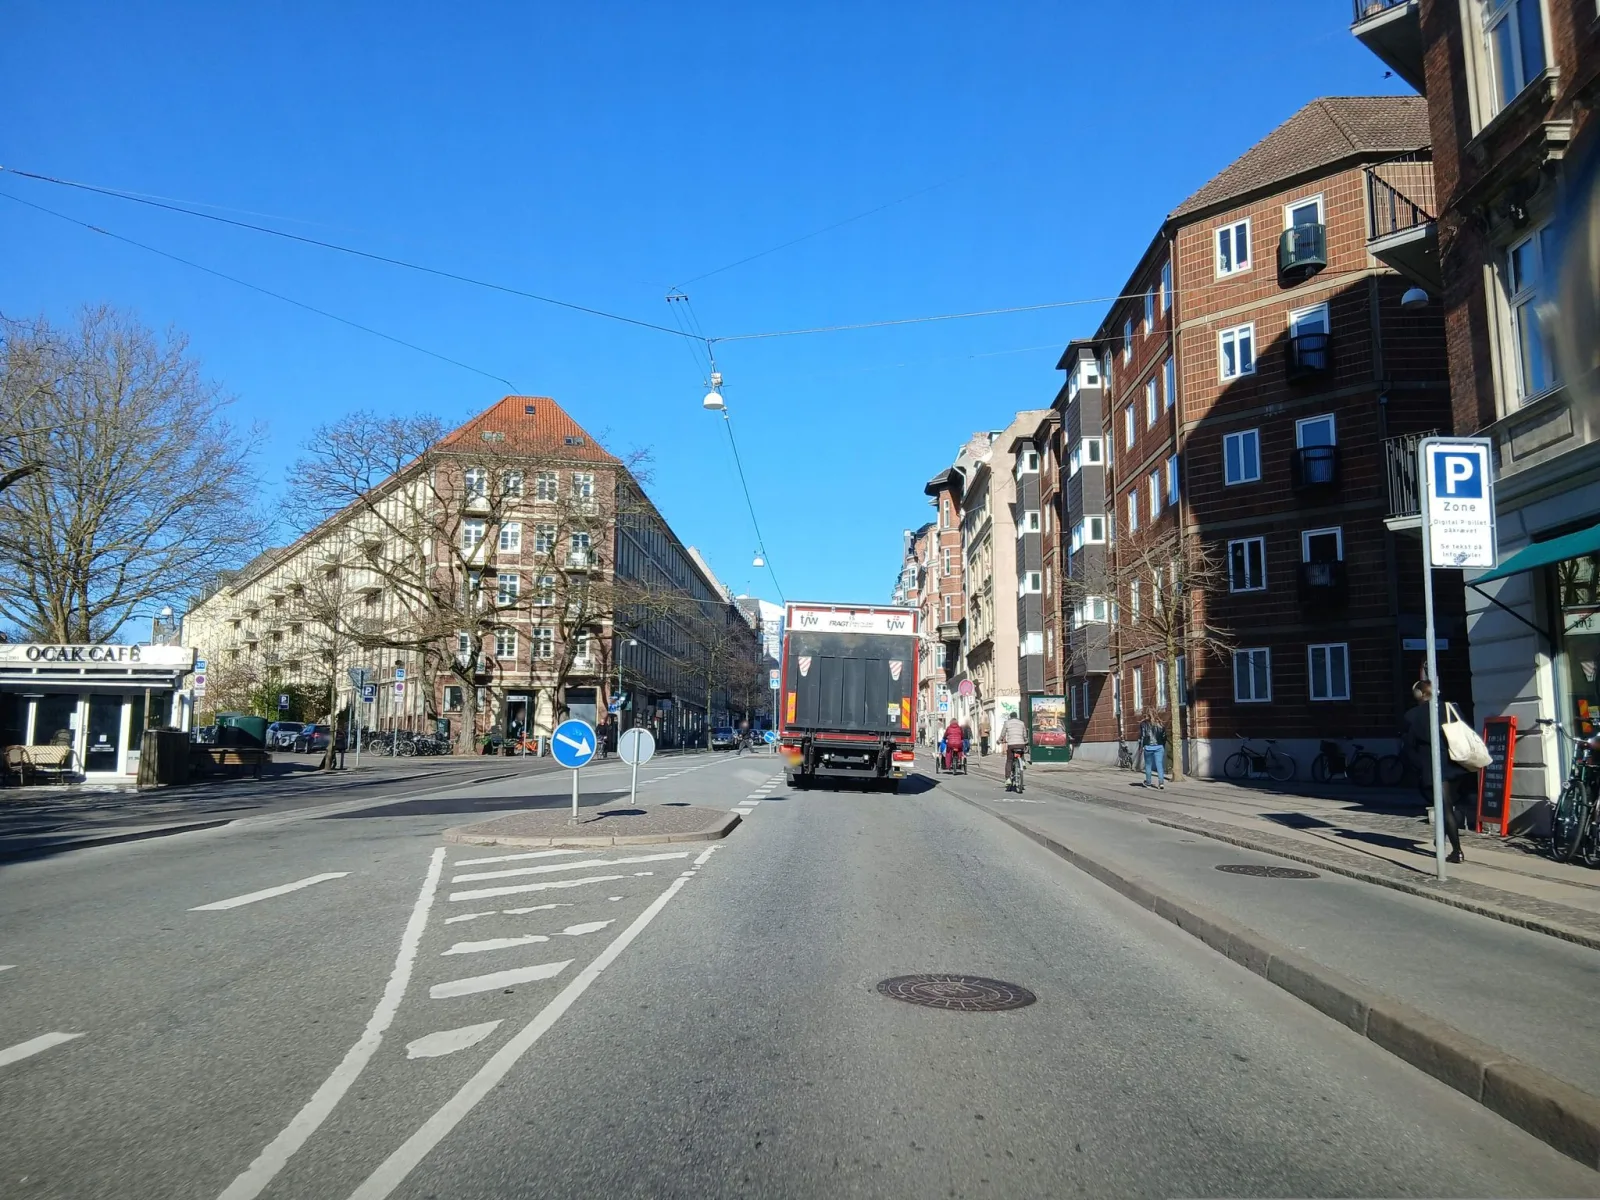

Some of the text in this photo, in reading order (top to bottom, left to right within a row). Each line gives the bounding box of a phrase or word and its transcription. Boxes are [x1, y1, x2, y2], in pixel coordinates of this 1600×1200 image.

[1445, 456, 1474, 494] P
[1443, 502, 1477, 512] Zone
[828, 619, 849, 628] FRAGT
[26, 646, 86, 662] OCAK
[365, 687, 372, 696] P
